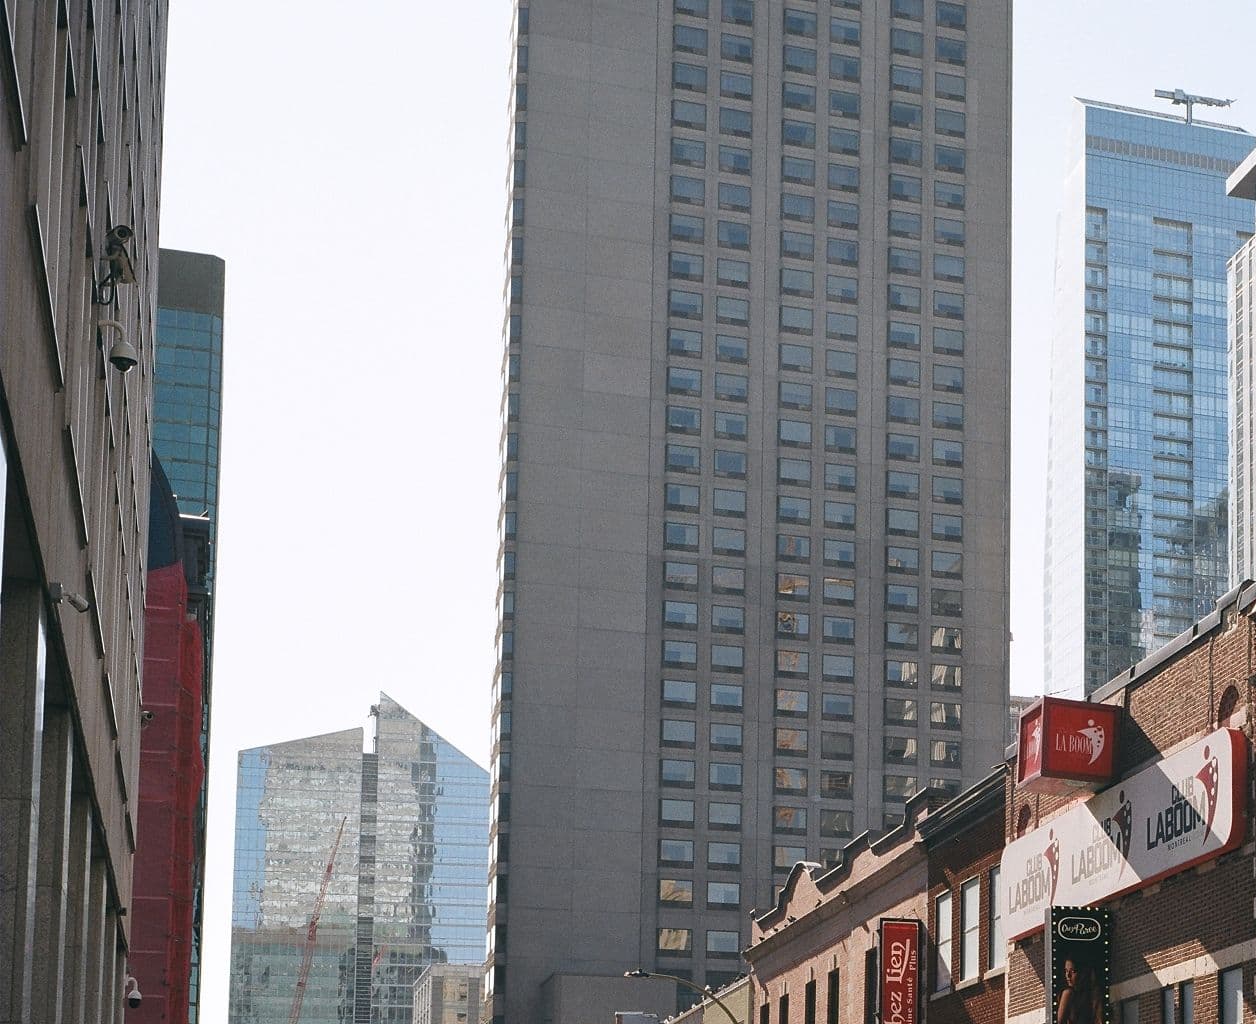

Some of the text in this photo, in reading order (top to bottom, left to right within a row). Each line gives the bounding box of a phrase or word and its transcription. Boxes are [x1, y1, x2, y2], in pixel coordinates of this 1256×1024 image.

[1055, 733, 1067, 752] LA
[1069, 735, 1093, 755] BOOM
[1172, 776, 1194, 805] CLUB
[1147, 791, 1206, 851] LABOOM
[1027, 853, 1042, 877] CLUB
[1071, 832, 1121, 885] LABOOM
[1008, 867, 1051, 915] LABOOM
